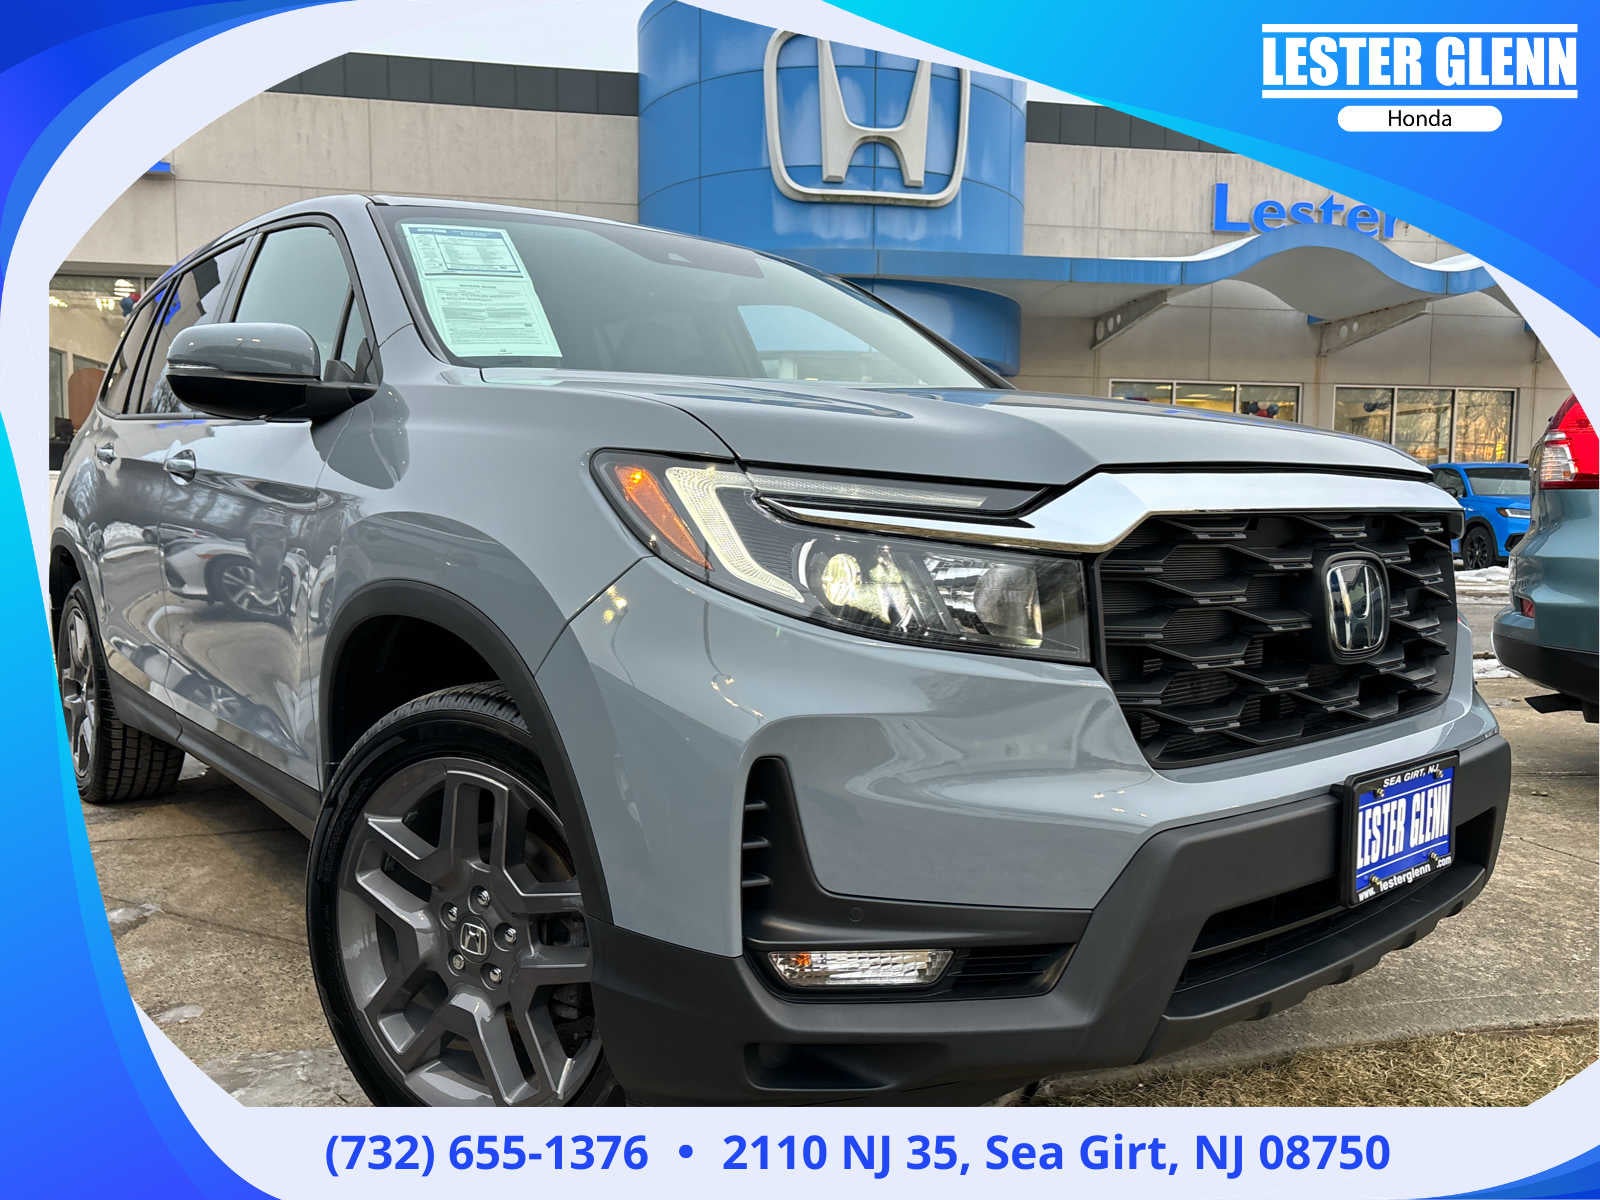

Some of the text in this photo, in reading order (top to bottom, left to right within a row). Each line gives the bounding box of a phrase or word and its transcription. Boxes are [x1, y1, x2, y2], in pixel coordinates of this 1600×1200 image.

[1213, 182, 1397, 239] Lester
[1382, 775, 1402, 788] SEA
[1356, 783, 1451, 869] LESTER GLENN
[1379, 863, 1431, 892] lesterglenn
